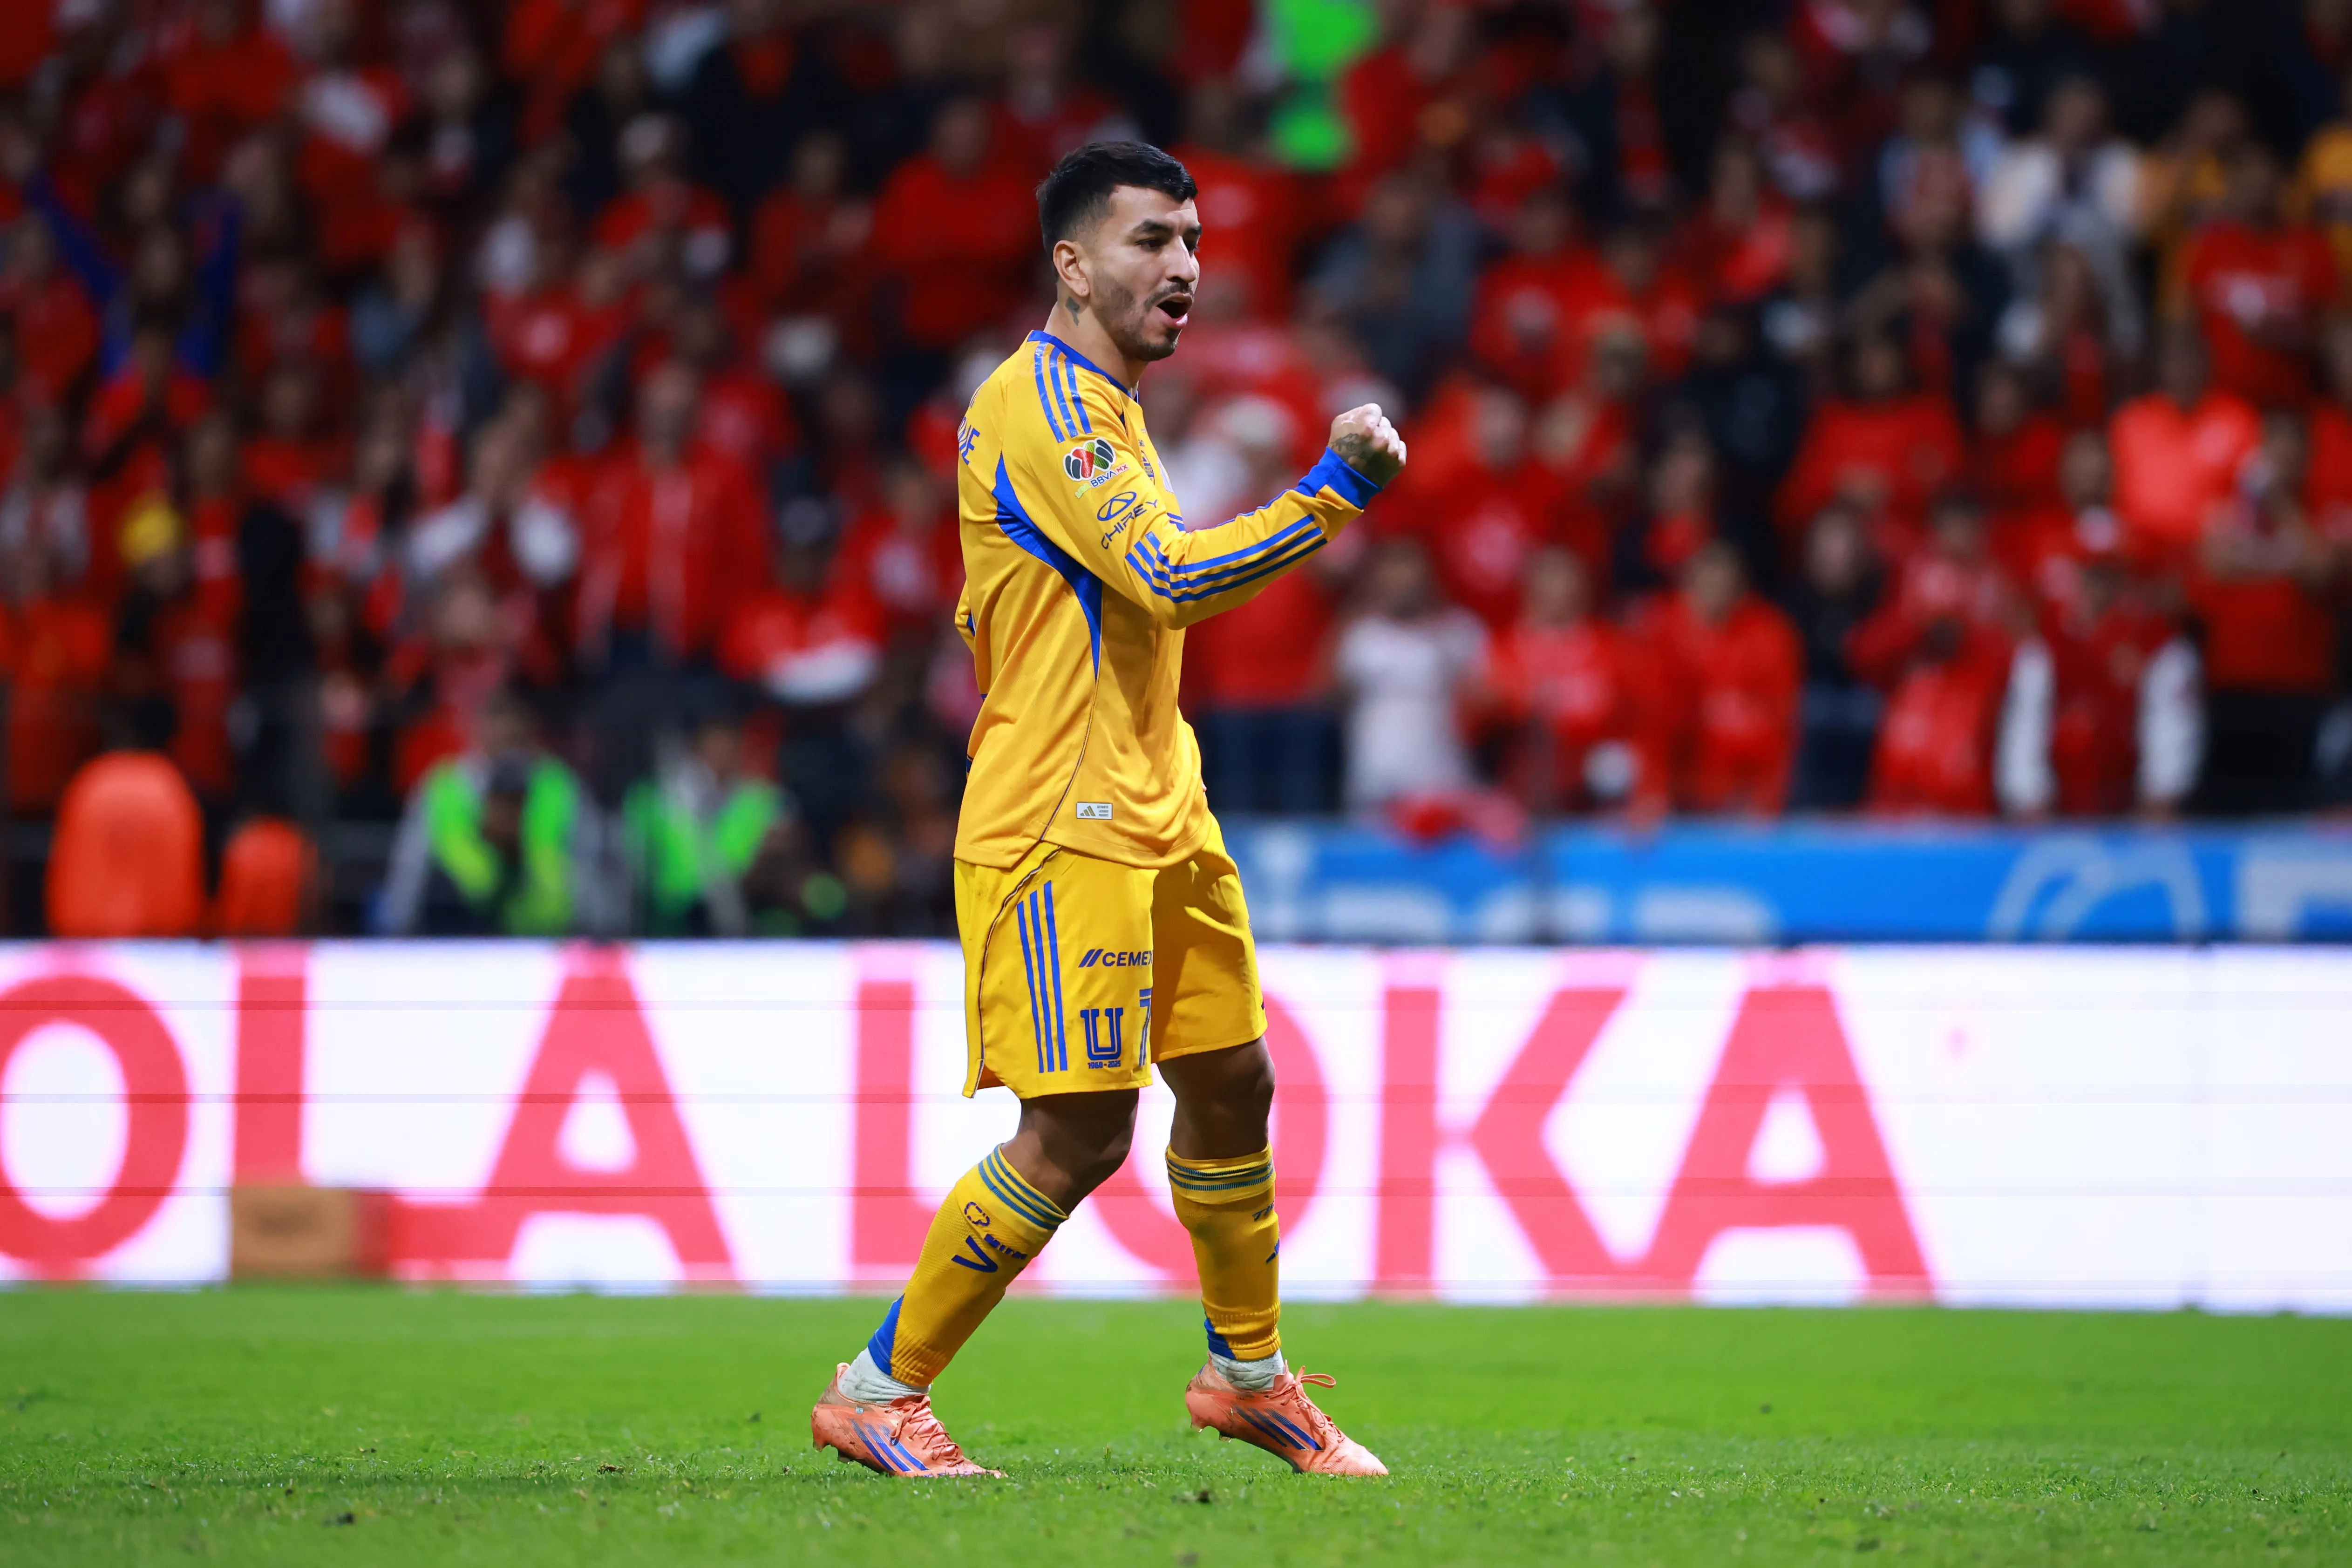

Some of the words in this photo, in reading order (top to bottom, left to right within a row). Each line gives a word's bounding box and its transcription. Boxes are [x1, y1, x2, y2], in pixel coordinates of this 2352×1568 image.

[1091, 471, 1117, 487] BBVA
[1116, 464, 1129, 473] MX
[1101, 499, 1157, 550] CHIREY
